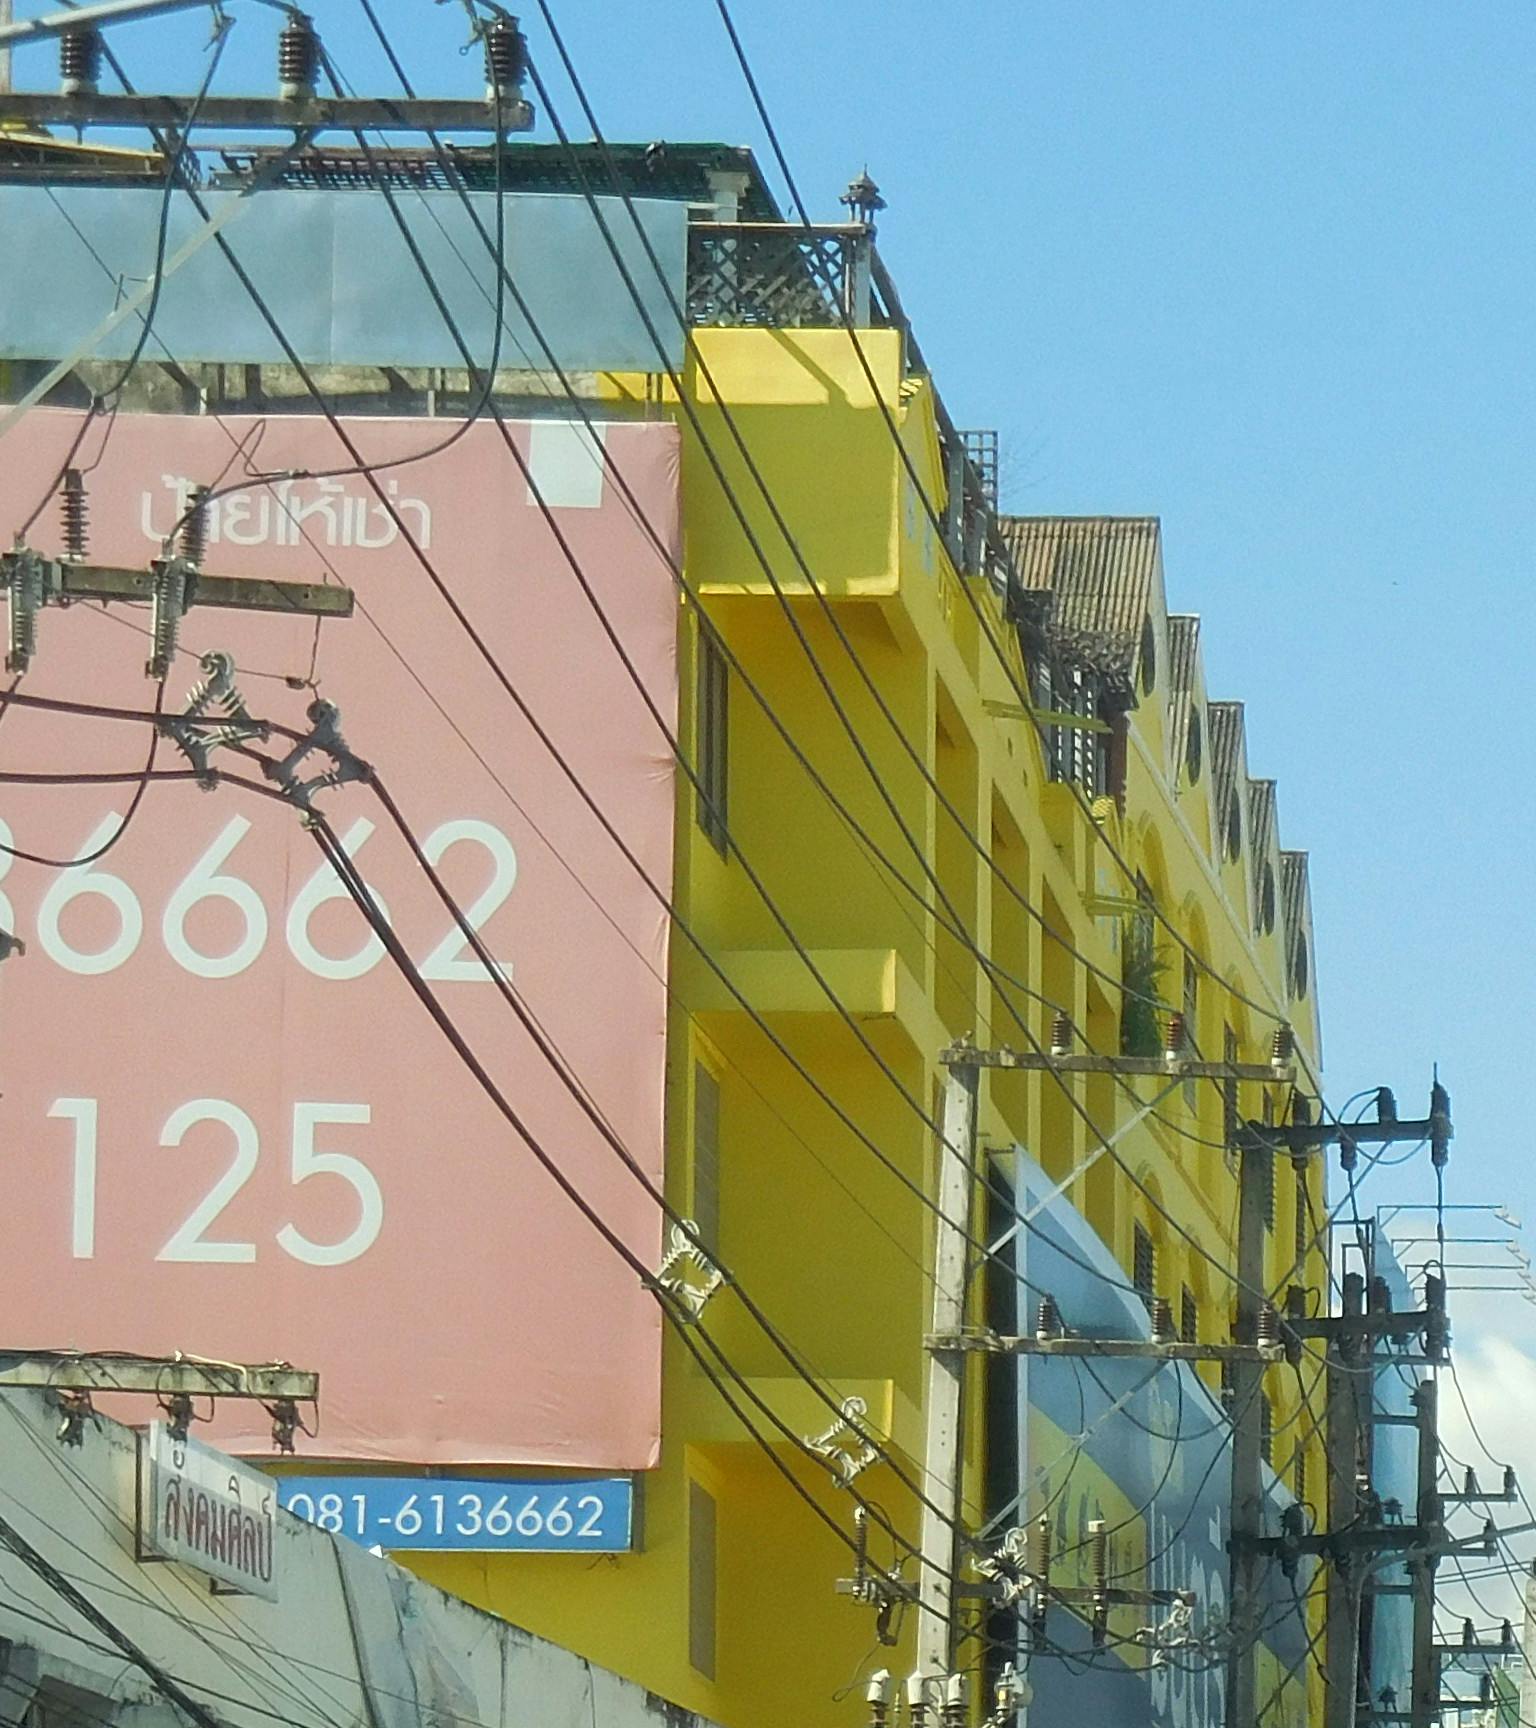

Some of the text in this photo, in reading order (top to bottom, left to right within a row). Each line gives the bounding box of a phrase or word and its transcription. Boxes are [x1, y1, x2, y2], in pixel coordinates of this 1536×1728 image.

[0, 811, 518, 981] 6662
[47, 1097, 386, 1267] 125
[287, 1493, 604, 1538] 081-6136662
